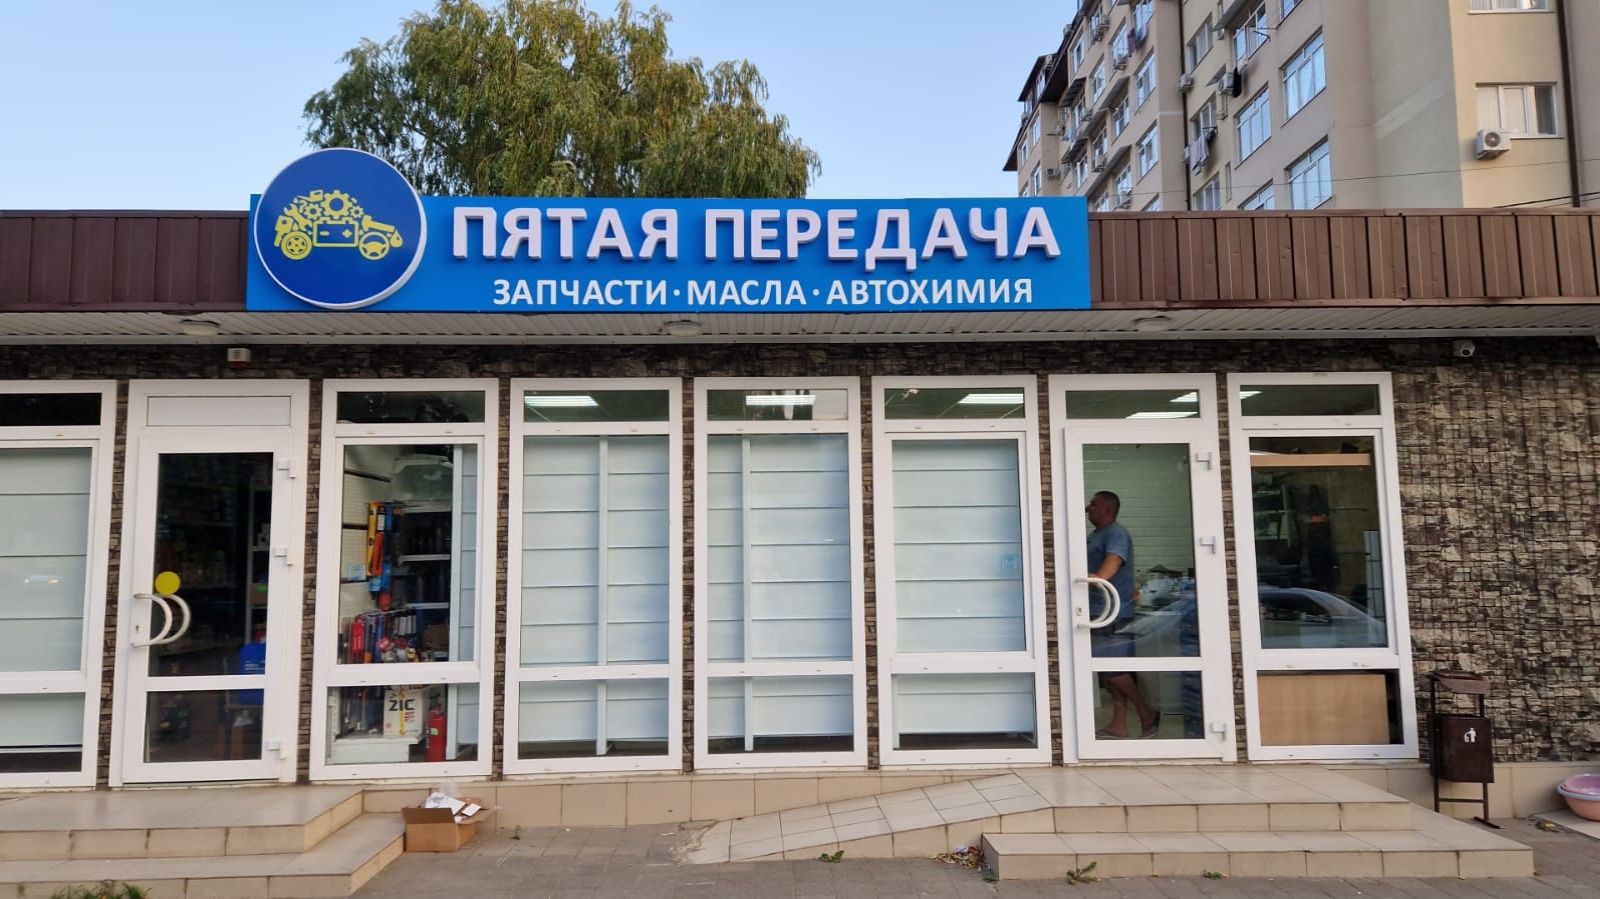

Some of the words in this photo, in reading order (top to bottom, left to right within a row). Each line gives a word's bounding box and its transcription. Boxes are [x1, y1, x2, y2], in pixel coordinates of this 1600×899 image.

[452, 206, 679, 260] ПЯТАЯ
[704, 206, 1062, 273] ПЕРЕДАЧА
[493, 279, 667, 306] ЗАПЧАСТИ
[687, 279, 808, 306] МАСЛА
[826, 278, 1033, 305] АВТОХИМИЯ
[388, 699, 415, 711] ZIC
